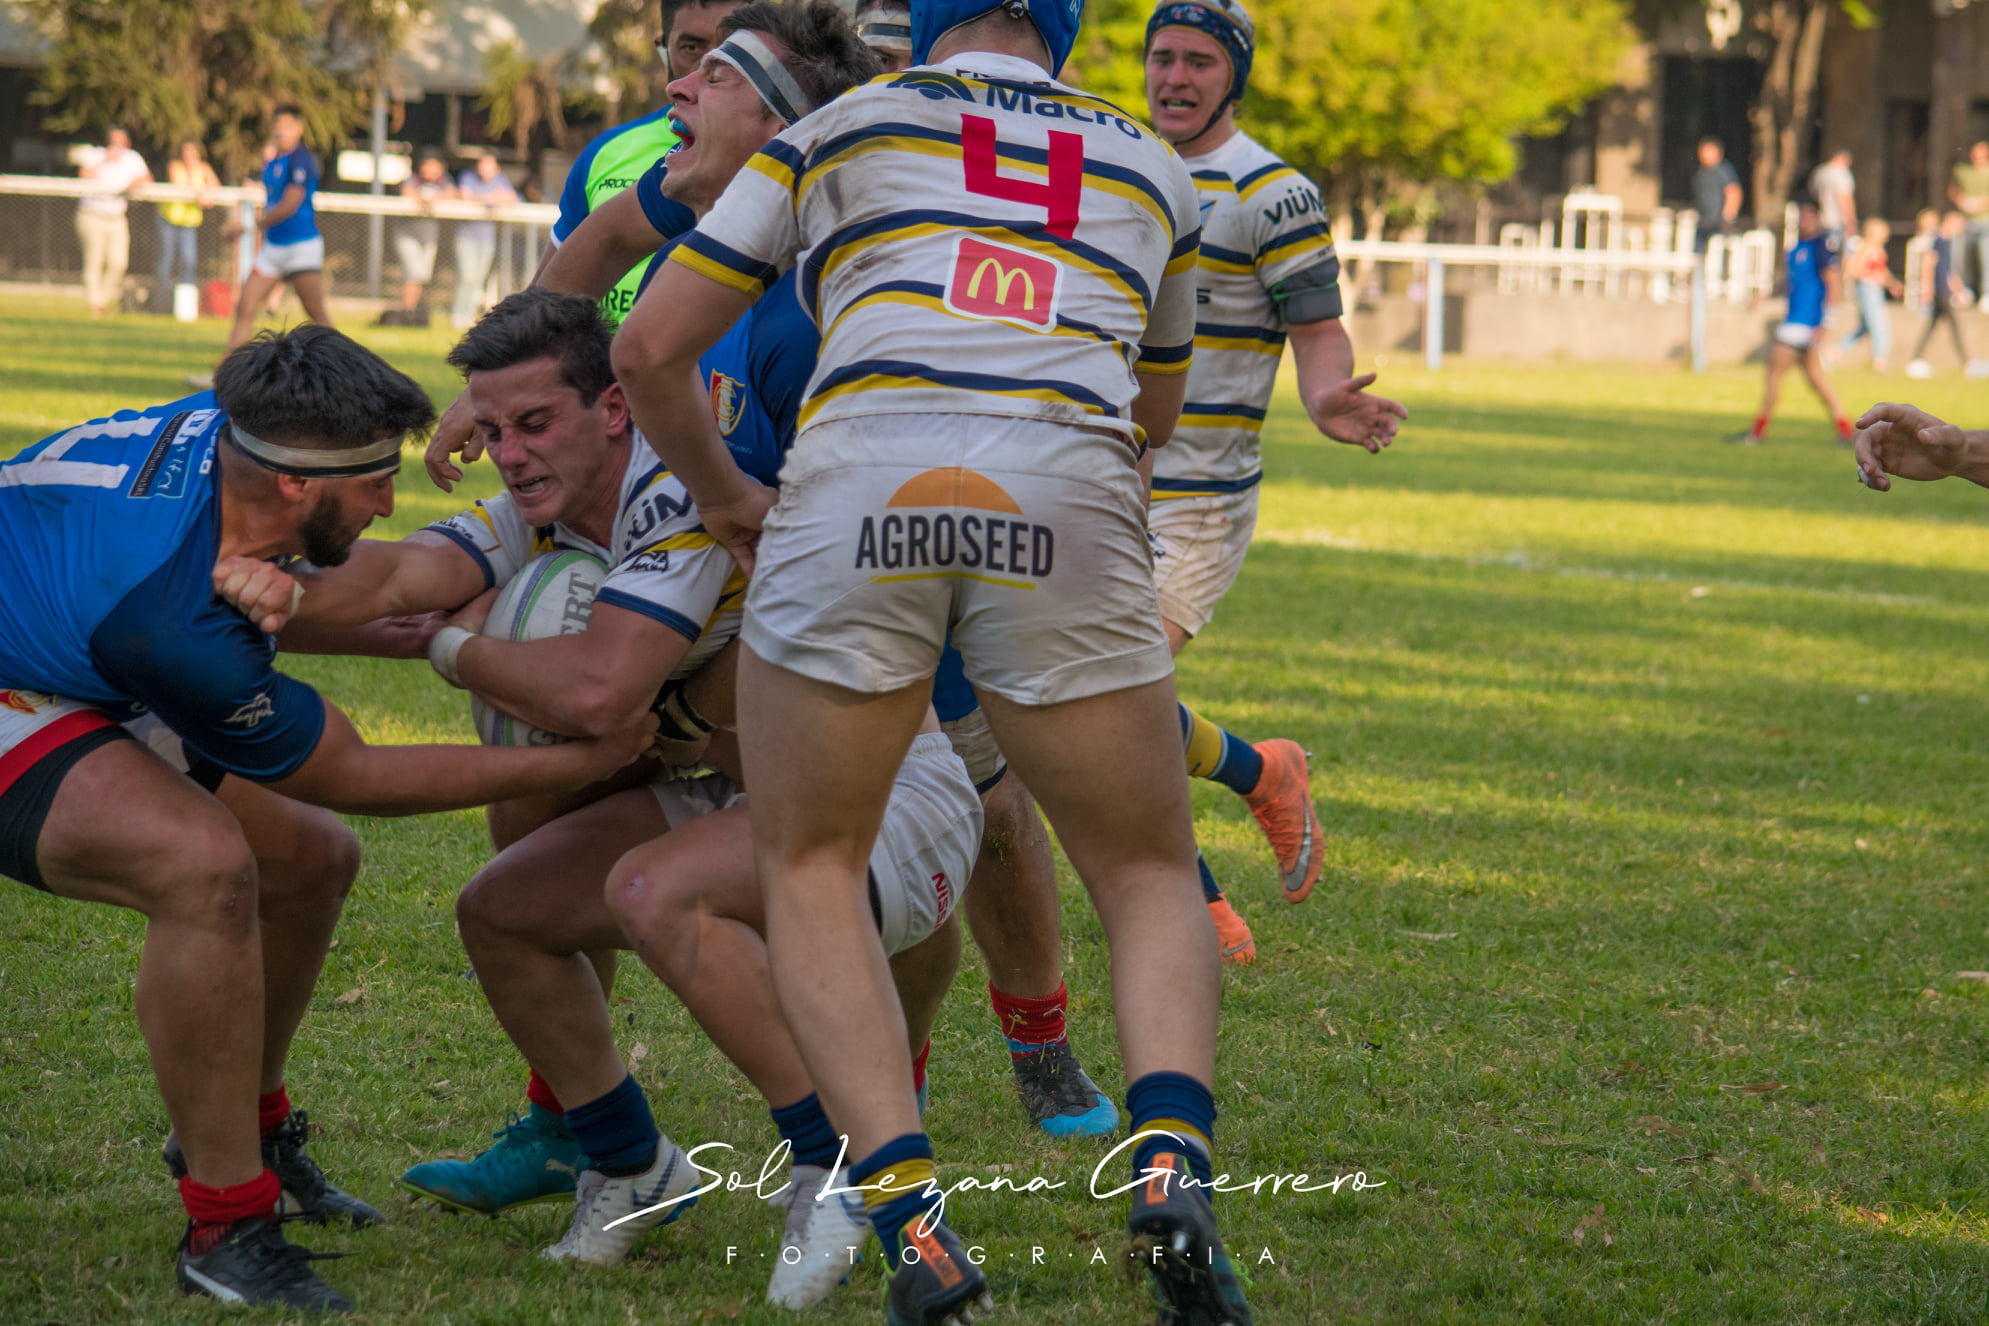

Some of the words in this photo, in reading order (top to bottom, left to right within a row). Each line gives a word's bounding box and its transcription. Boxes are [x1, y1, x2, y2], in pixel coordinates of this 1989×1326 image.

[984, 84, 1142, 140] Macro
[960, 113, 1083, 241] 4
[855, 514, 1054, 577] AGROSEED
